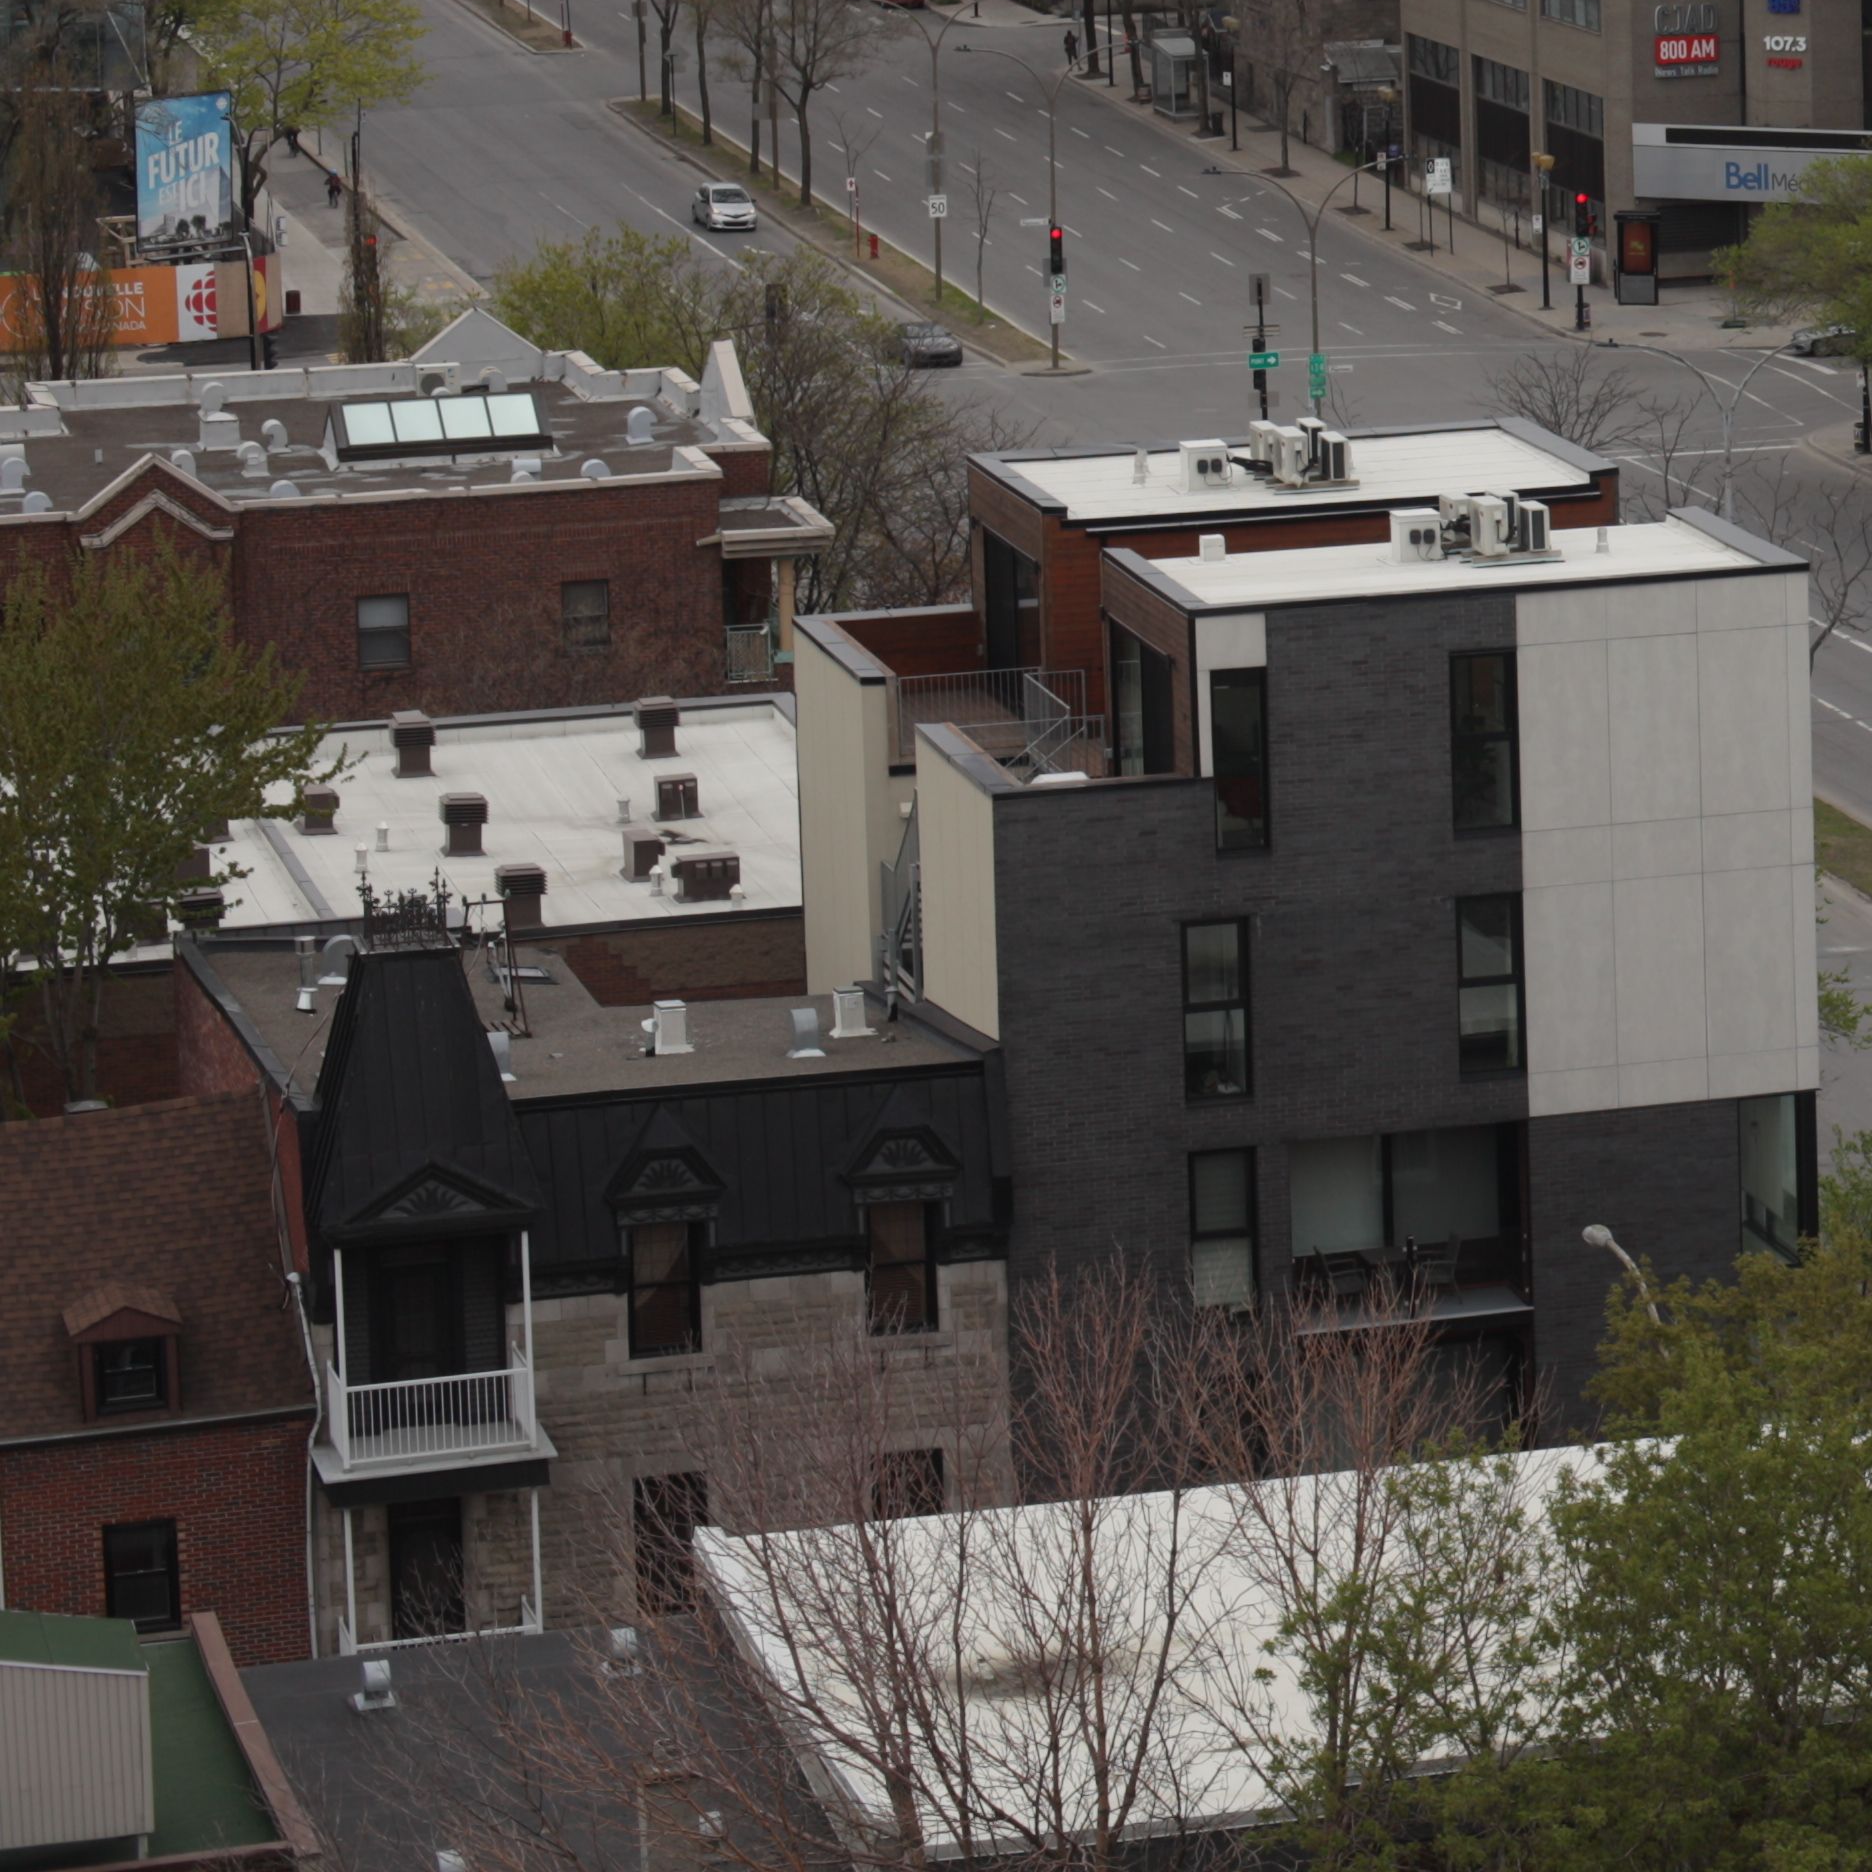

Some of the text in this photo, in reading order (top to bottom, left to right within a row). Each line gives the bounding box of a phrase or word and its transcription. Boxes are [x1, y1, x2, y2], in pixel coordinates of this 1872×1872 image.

[1655, 4, 1718, 34] CJAD
[1660, 39, 1715, 60] 800 AM
[1763, 36, 1807, 52] 107.3
[1697, 64, 1719, 75] Radio
[168, 120, 182, 146] LE
[147, 132, 220, 190] FUTUR
[1725, 162, 1769, 190] Bell
[159, 171, 206, 213] EST ICI
[931, 202, 945, 215] 50
